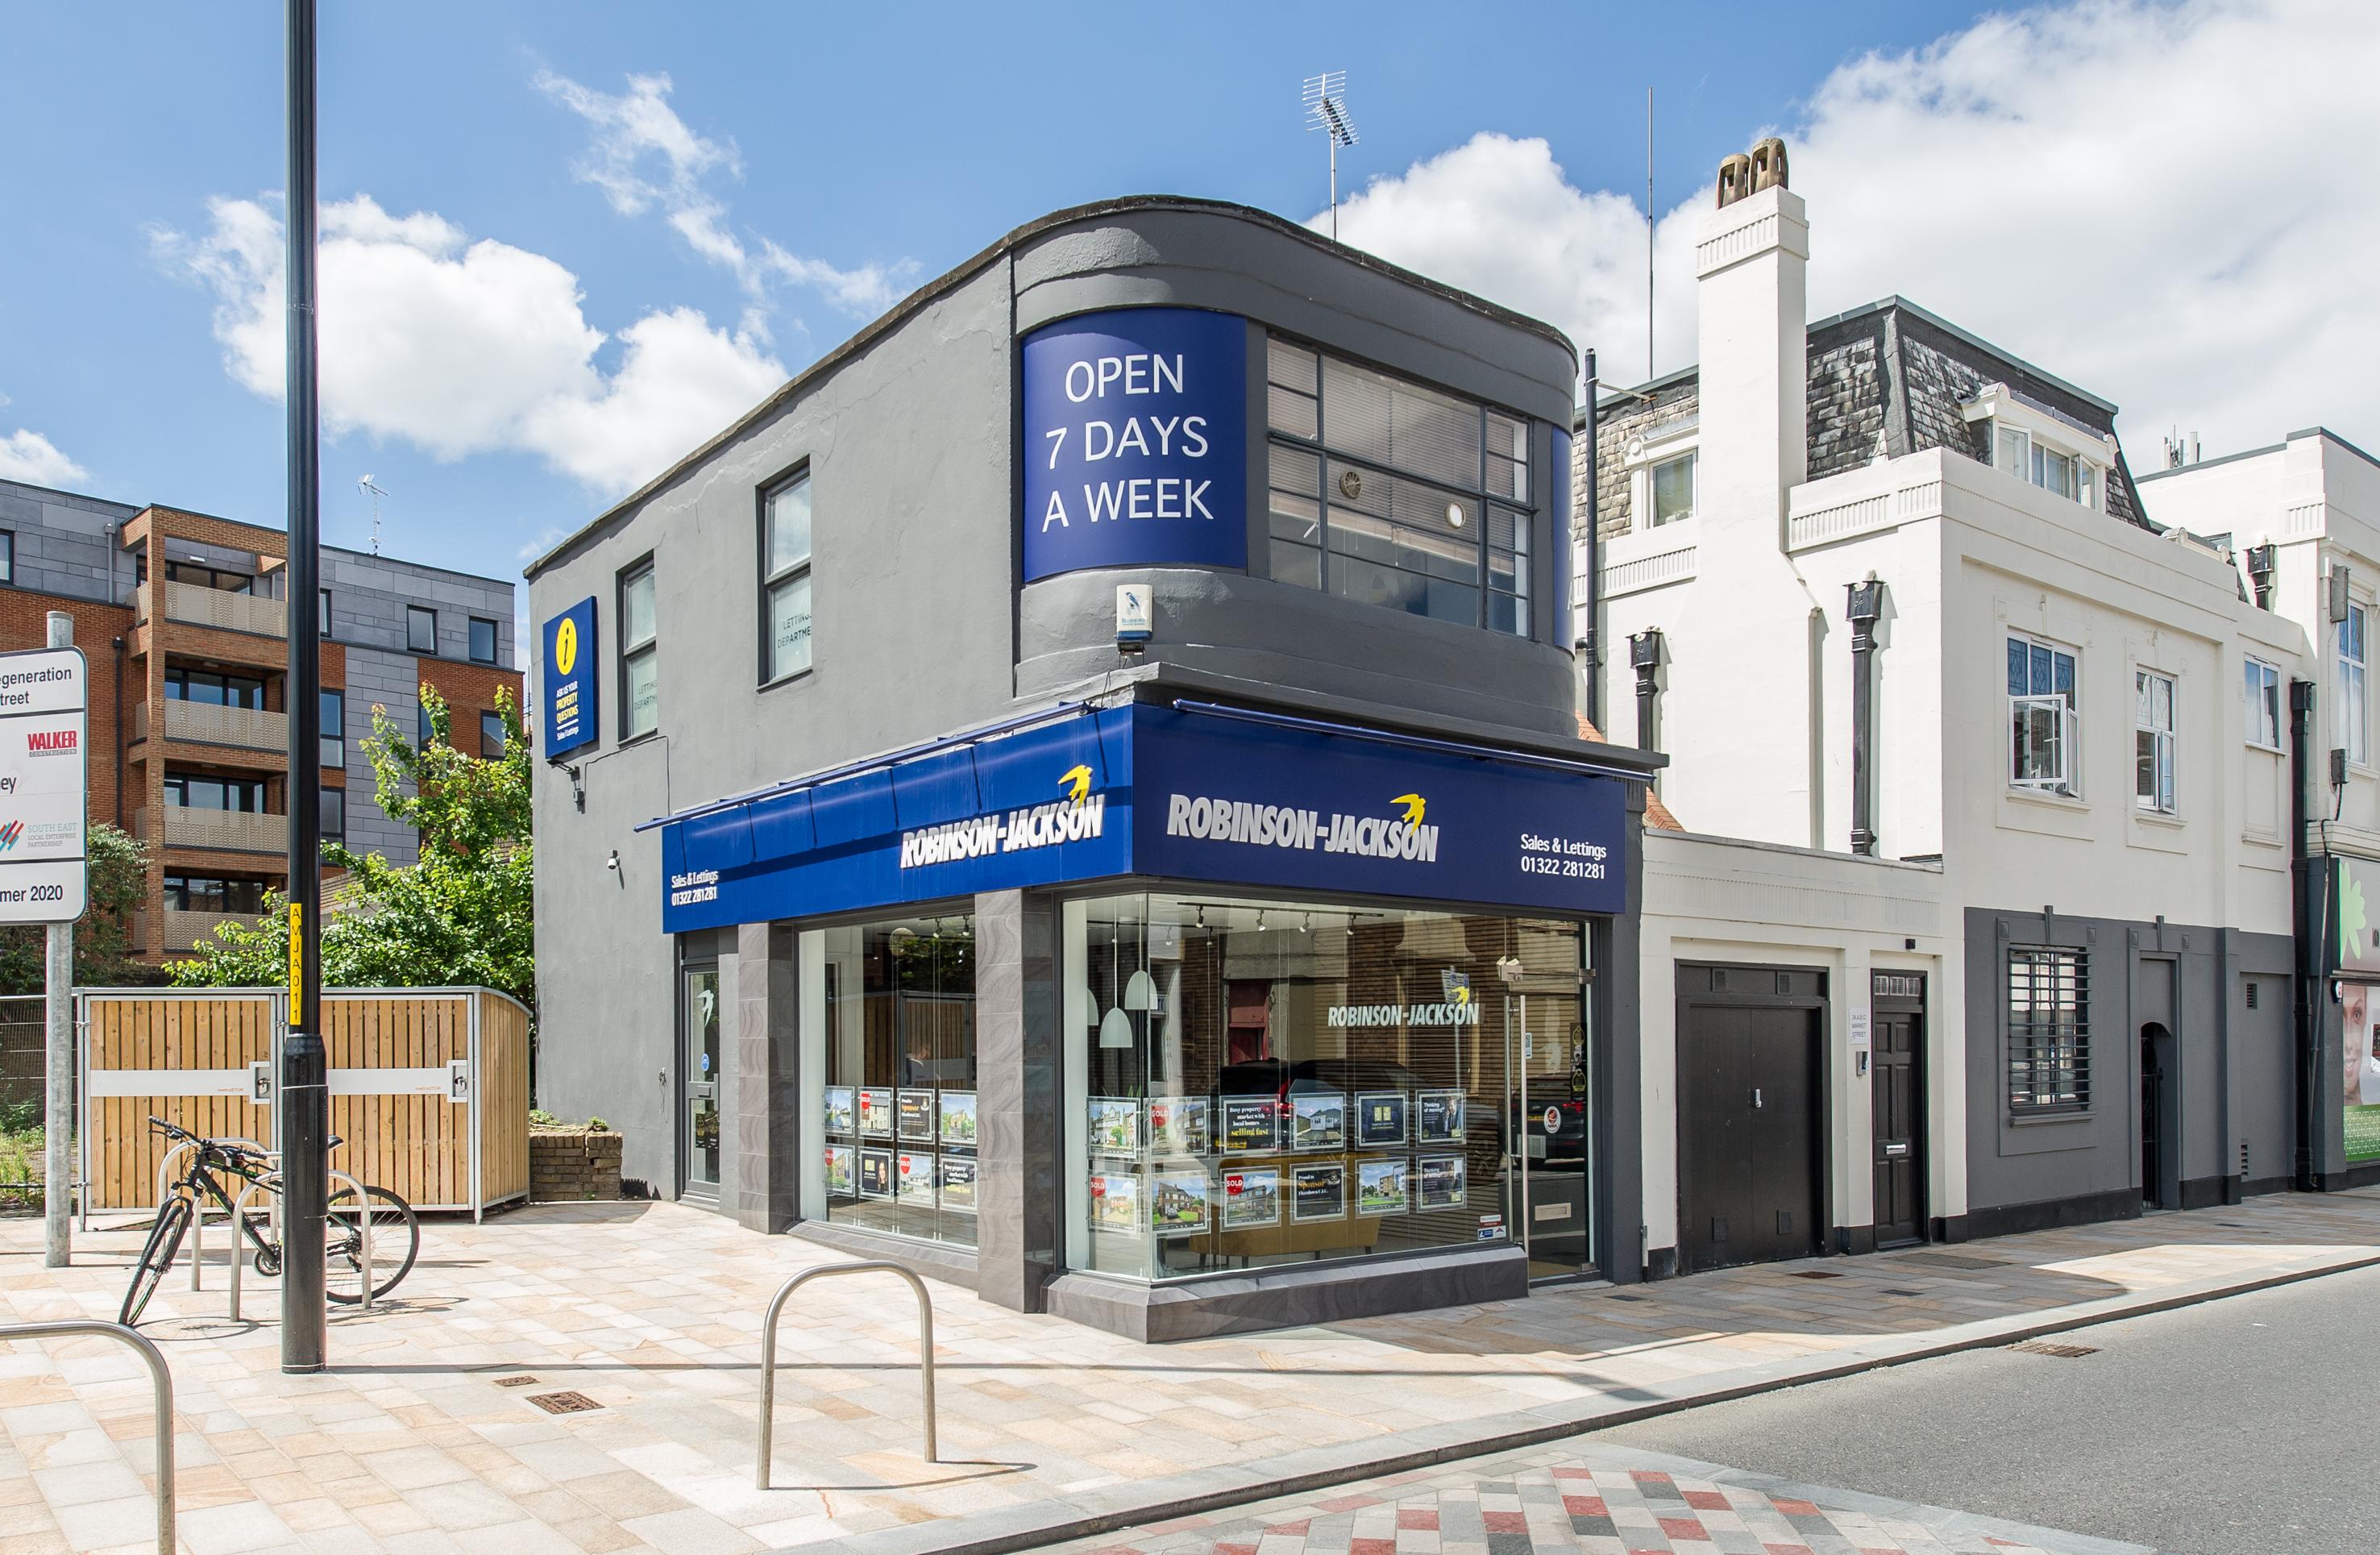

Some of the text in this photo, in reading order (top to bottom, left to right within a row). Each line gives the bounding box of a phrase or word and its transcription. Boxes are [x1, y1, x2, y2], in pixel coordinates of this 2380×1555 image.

[1065, 354, 1183, 403] OPEN
[1045, 416, 1208, 470] 7 DAYS
[1042, 479, 1214, 533] A WEEK
[0, 667, 72, 688] generation
[0, 691, 29, 706] treet
[557, 692, 578, 711] PROPERTY
[557, 705, 579, 724] QUESTIONS
[27, 730, 77, 750] WALKER
[30, 748, 77, 757] CONSTRUCTION
[0, 777, 17, 794] ey
[27, 822, 78, 834] SOUTH EAST
[900, 794, 1105, 869] ROBINSON-JACKSON
[1167, 794, 1439, 862] ROBINSON-JACKSON
[1521, 834, 1607, 861] Sales & Lettings
[1521, 856, 1605, 879] 01322 281281
[671, 869, 718, 888] Sales & Lettings
[0, 884, 64, 902] mer 2020
[671, 887, 717, 906] 01322 281281
[292, 908, 302, 1020] AMJA011
[1328, 1003, 1479, 1027] ROBINSON-JACKSON
[1231, 1128, 1269, 1137] selling fast
[1090, 1181, 1105, 1189] SOLD
[1227, 1179, 1244, 1187] SOLD
[1298, 1181, 1325, 1190] Sponsor
